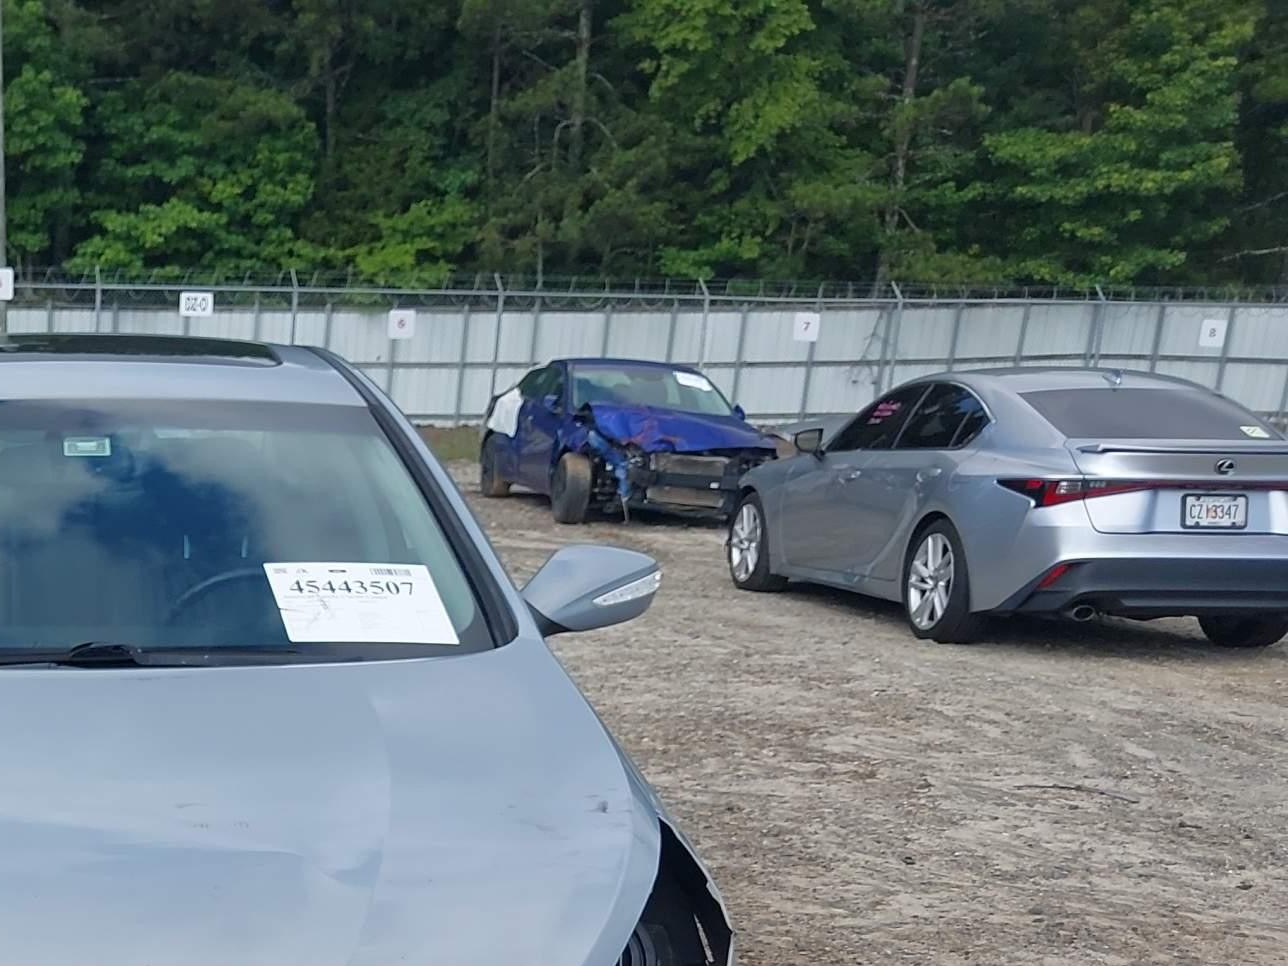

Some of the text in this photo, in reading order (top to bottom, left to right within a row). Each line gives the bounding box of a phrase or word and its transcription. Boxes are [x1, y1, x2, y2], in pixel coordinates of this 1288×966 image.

[803, 321, 811, 331] 7
[1209, 328, 1217, 338] 8
[289, 579, 413, 595] 45443507
